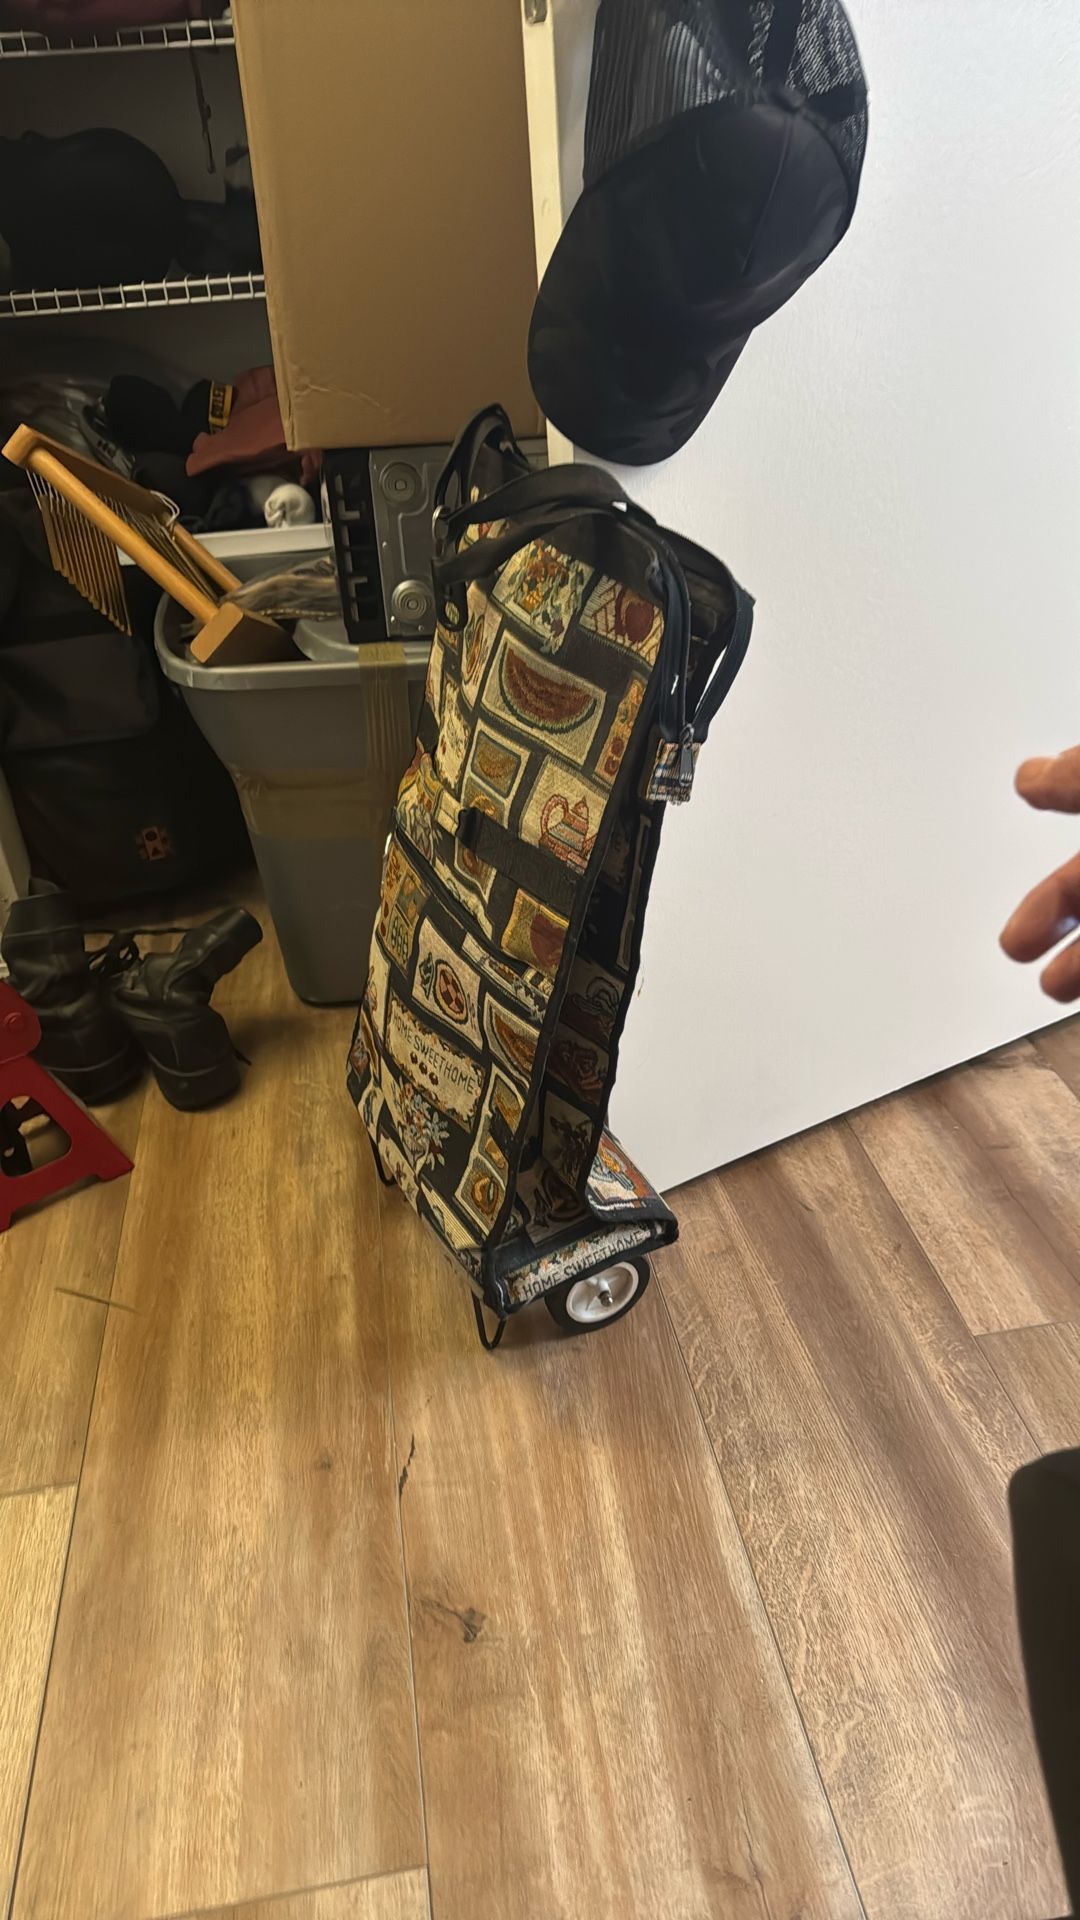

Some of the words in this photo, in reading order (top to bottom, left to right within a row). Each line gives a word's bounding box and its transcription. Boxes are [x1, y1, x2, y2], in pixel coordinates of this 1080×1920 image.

[393, 1015, 413, 1043] HOME
[413, 1035, 446, 1071] SWEET
[443, 1060, 475, 1095] HOME
[522, 1272, 561, 1297] HOME
